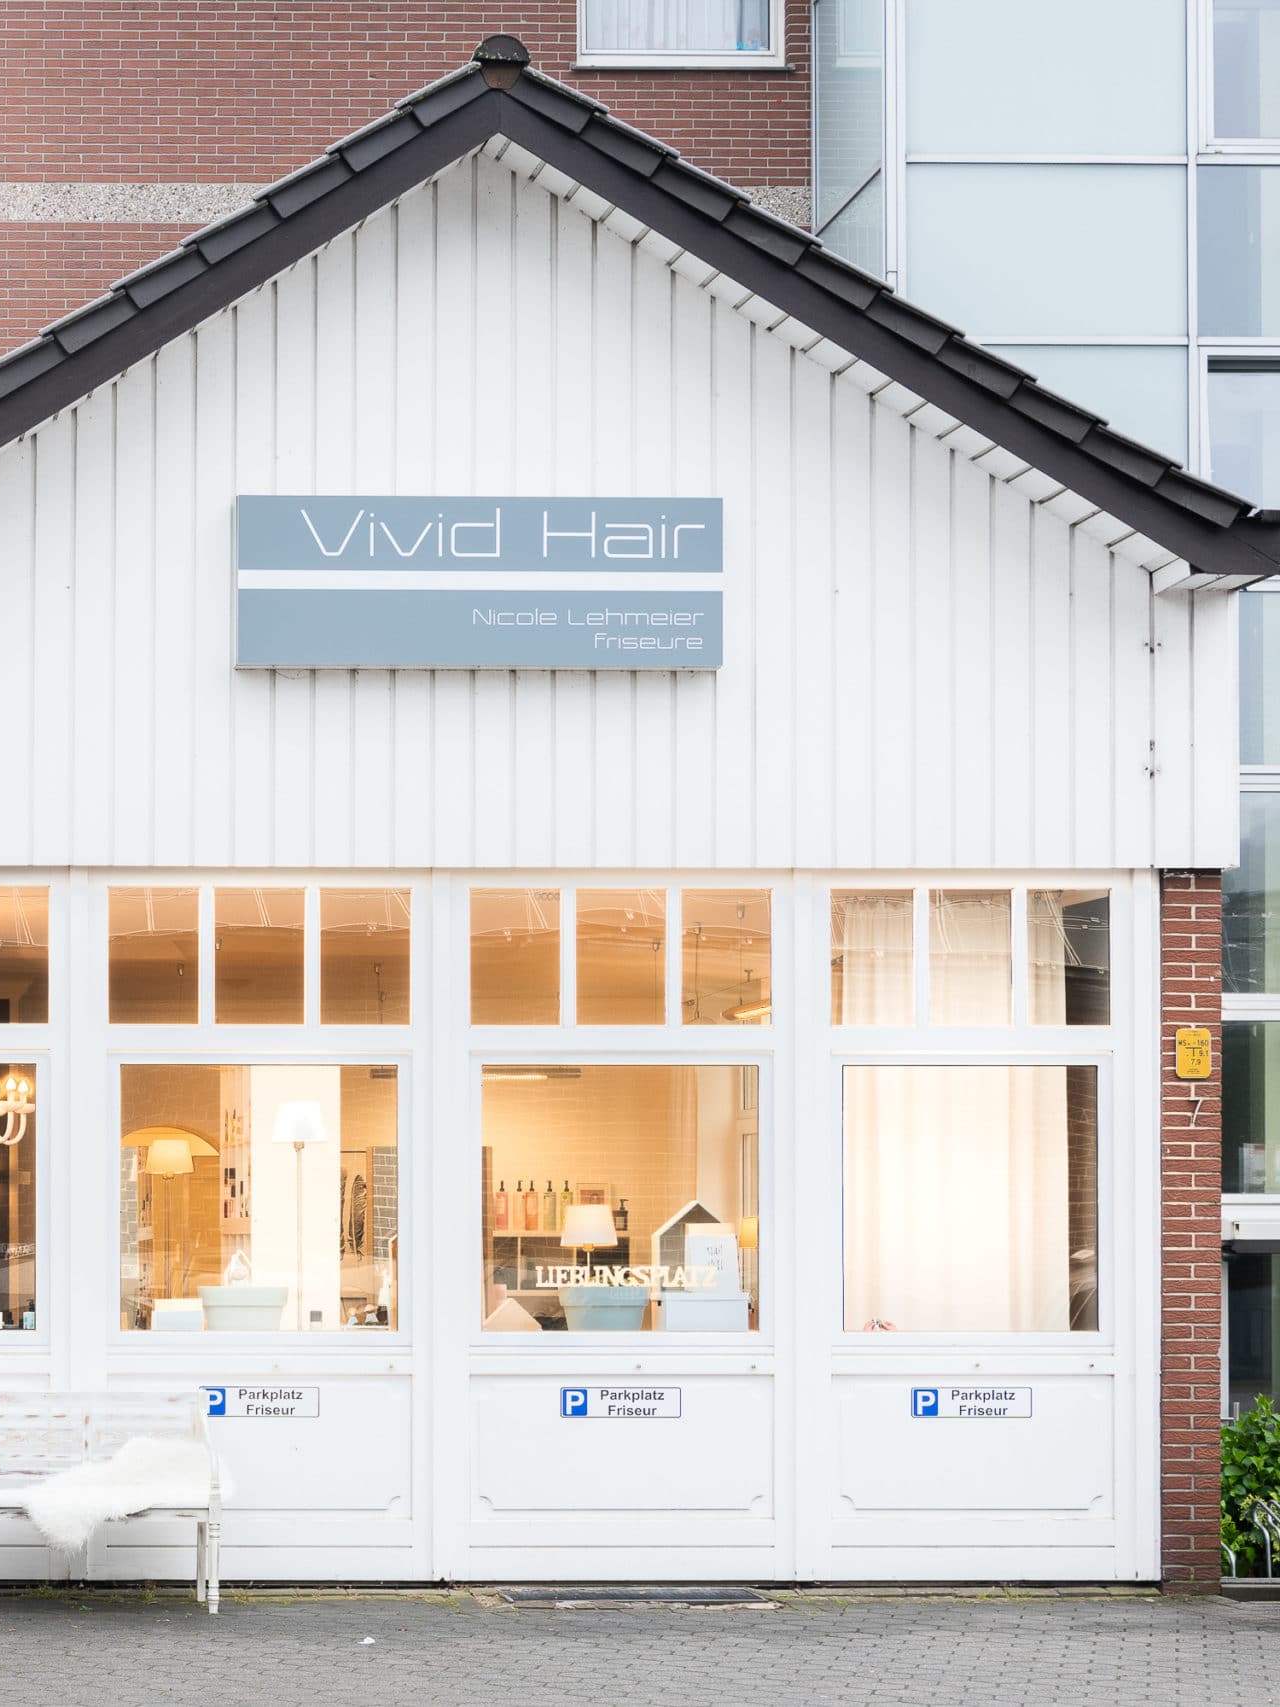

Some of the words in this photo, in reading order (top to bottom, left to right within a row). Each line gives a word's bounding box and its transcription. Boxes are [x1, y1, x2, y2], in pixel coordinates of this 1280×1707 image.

[300, 507, 501, 558] Vivid
[542, 510, 706, 559] Hair
[471, 607, 558, 626] Nicole
[567, 607, 705, 626] Lehmeier
[593, 632, 704, 650] Friseure
[1189, 1097, 1203, 1127] 7
[535, 1264, 718, 1288] LIEBLINGSPLATZ
[206, 1389, 224, 1415] P
[238, 1388, 304, 1402] Parkplatz
[246, 1404, 296, 1416] Friseur
[565, 1390, 585, 1415] P
[600, 1389, 665, 1403] Parkplatz
[608, 1404, 658, 1416] Friseur
[916, 1391, 936, 1416] P
[951, 1389, 1016, 1403] Parkplatz
[958, 1404, 1008, 1416] Friseur
